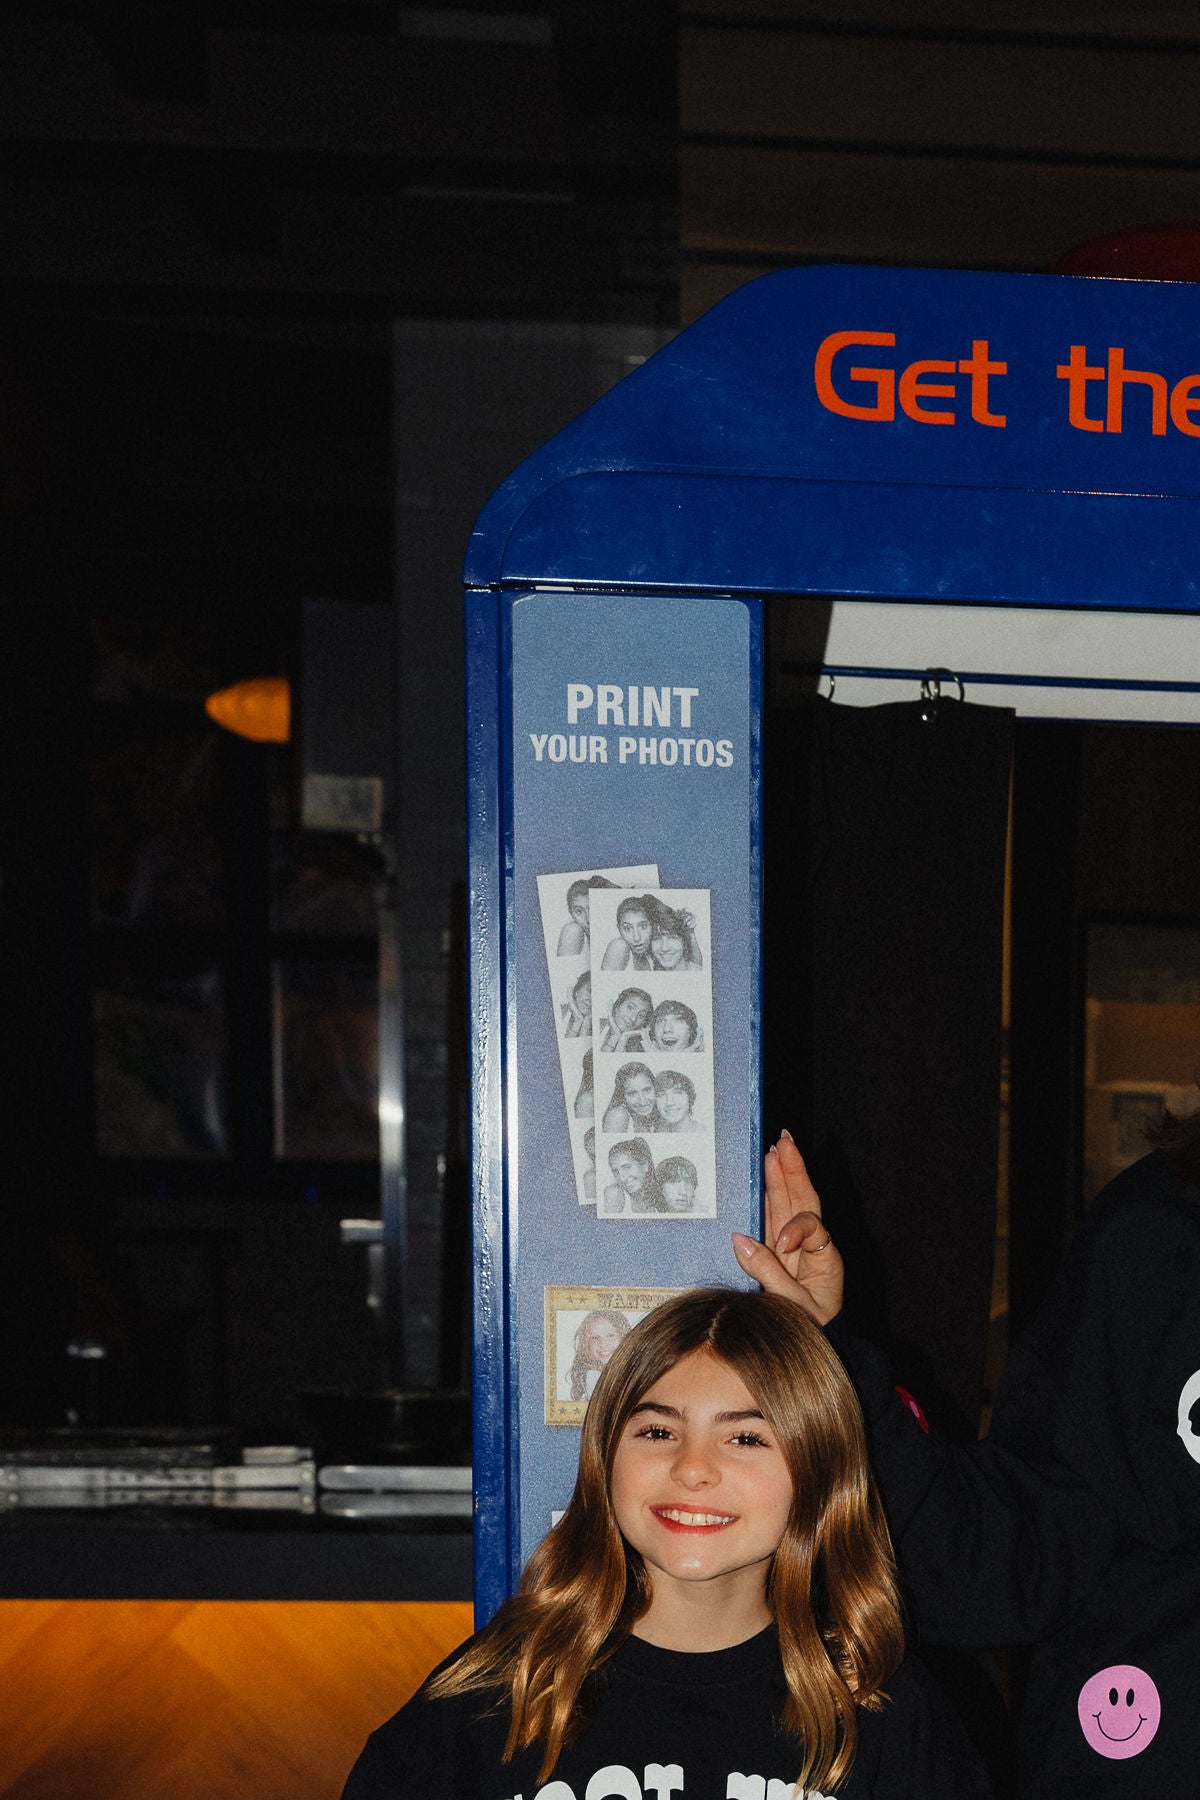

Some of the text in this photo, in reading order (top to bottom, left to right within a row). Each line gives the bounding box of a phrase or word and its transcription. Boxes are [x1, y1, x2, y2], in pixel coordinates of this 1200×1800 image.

[814, 330, 1008, 428] Get
[567, 683, 699, 728] PRINT
[529, 733, 734, 768] YOUR PHOTOS
